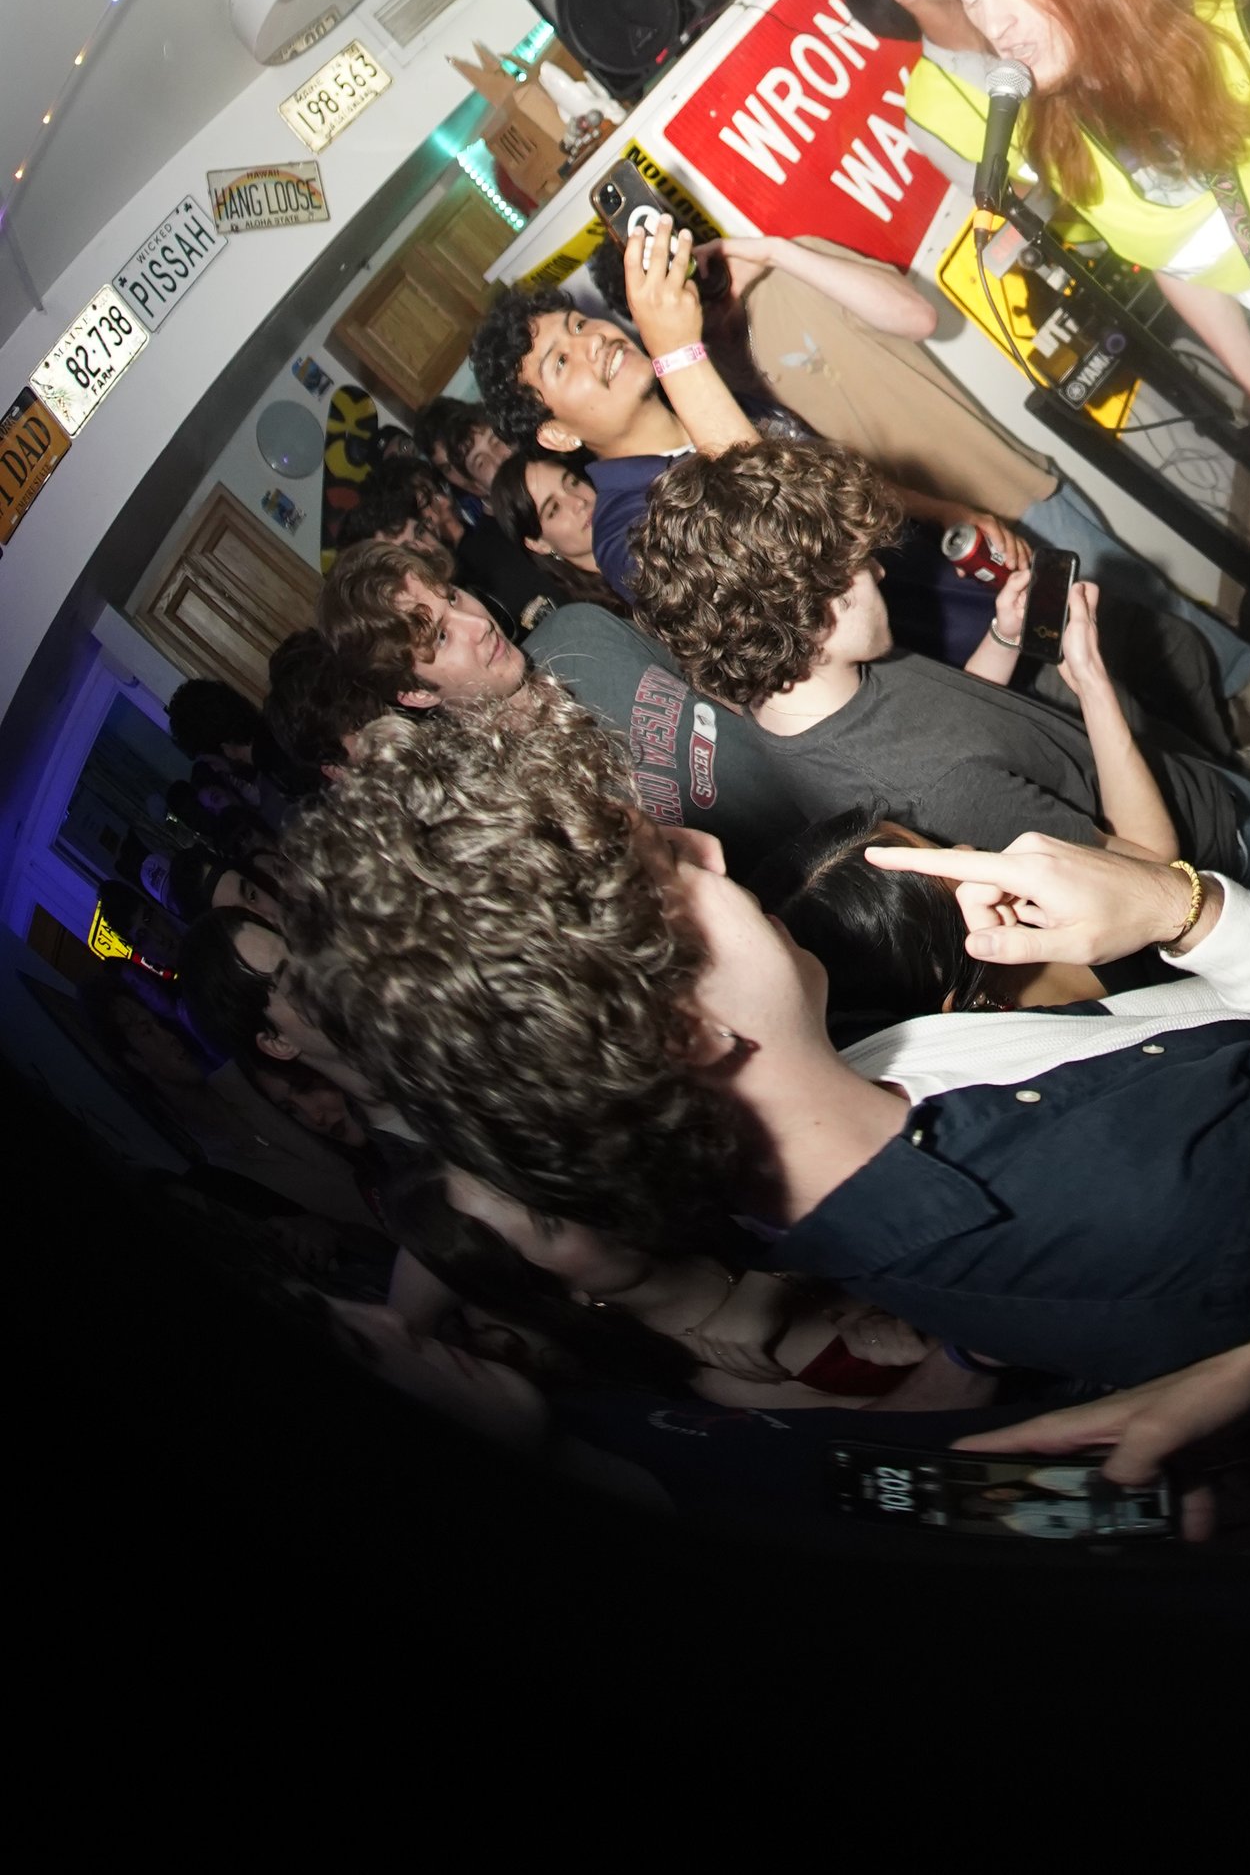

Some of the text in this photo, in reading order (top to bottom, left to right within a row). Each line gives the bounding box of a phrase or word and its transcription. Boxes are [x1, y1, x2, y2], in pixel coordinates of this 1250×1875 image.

[213, 177, 323, 222] HANG LOOSE
[245, 214, 301, 229] ALOHA STATE
[129, 215, 216, 318] PISSAH
[135, 222, 174, 265] WICKED
[53, 312, 92, 363] MAINE
[90, 365, 117, 397] FARM
[1075, 350, 1115, 387] YAMA
[1, 415, 52, 491] DAD
[694, 746, 712, 798] SOCCER
[632, 771, 684, 827] HIO
